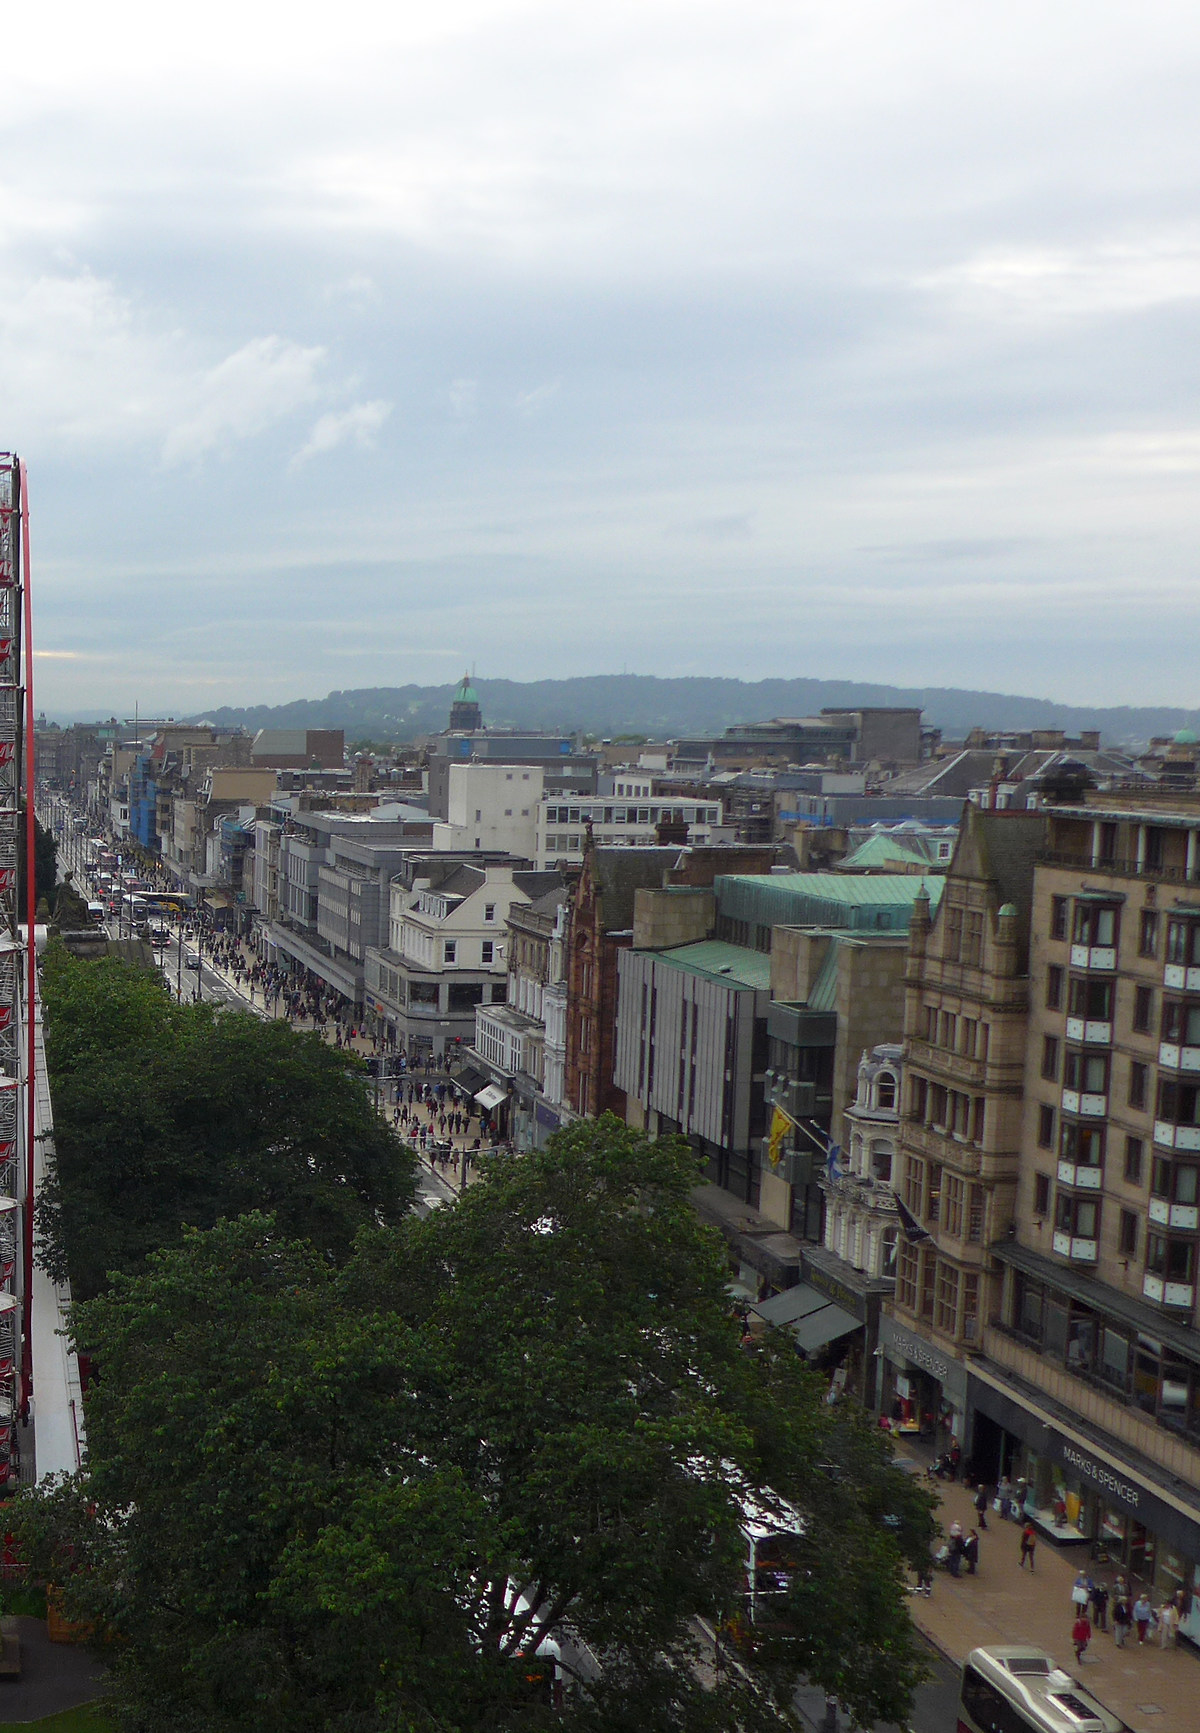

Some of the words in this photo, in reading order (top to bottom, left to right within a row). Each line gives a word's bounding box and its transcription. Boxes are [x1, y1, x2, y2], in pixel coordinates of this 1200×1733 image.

[892, 1333, 914, 1356] MARKS
[919, 1349, 949, 1380] SPENCER
[1063, 1446, 1091, 1475] MARKS
[1098, 1469, 1139, 1508] SPENCER
